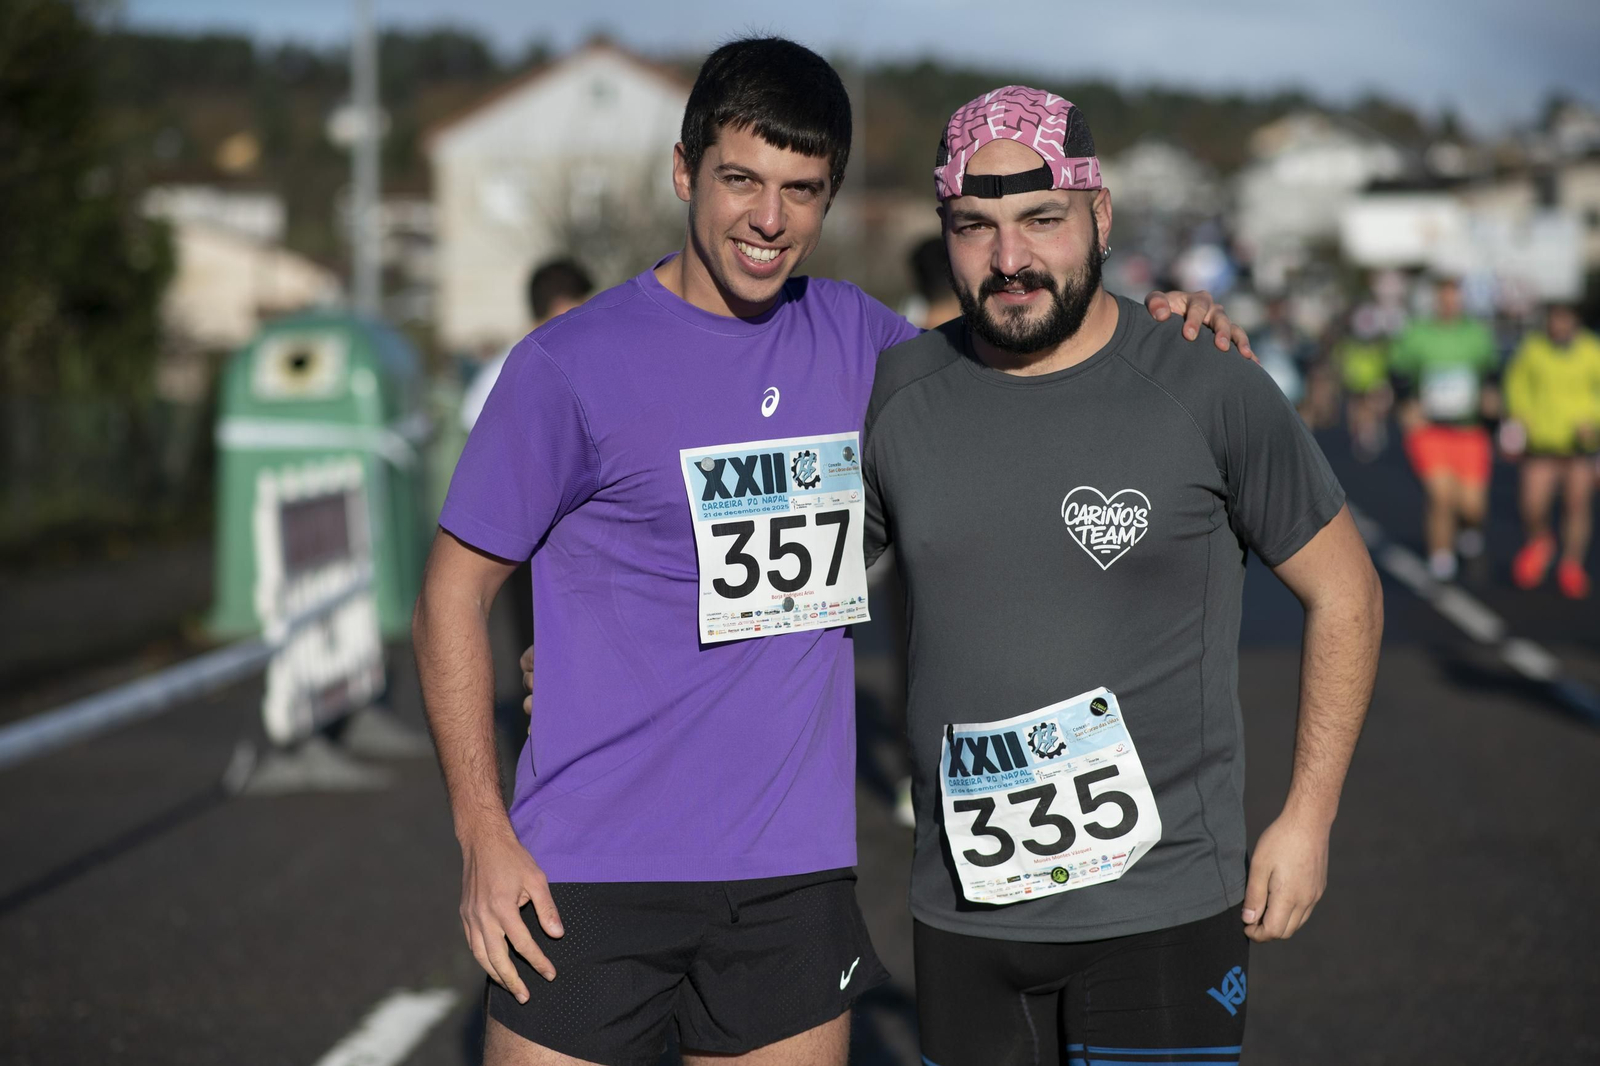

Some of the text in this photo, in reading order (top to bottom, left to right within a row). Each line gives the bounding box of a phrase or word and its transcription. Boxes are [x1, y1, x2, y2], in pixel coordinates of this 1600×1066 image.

[694, 452, 787, 501] XXII
[702, 499, 743, 511] CARREIRA
[747, 497, 758, 506] DO
[762, 495, 788, 505] NADAL
[723, 507, 761, 517] decembro
[1074, 525, 1136, 547] TEAM
[711, 509, 850, 599] 357
[1072, 722, 1091, 732] Conce
[948, 731, 1028, 778] XXII
[948, 777, 982, 787] CARREIRA
[986, 775, 998, 783] DO
[1001, 769, 1032, 781] NADAL
[966, 784, 1002, 793] decembro
[1014, 777, 1035, 785] 2025
[953, 764, 1139, 868] 335
